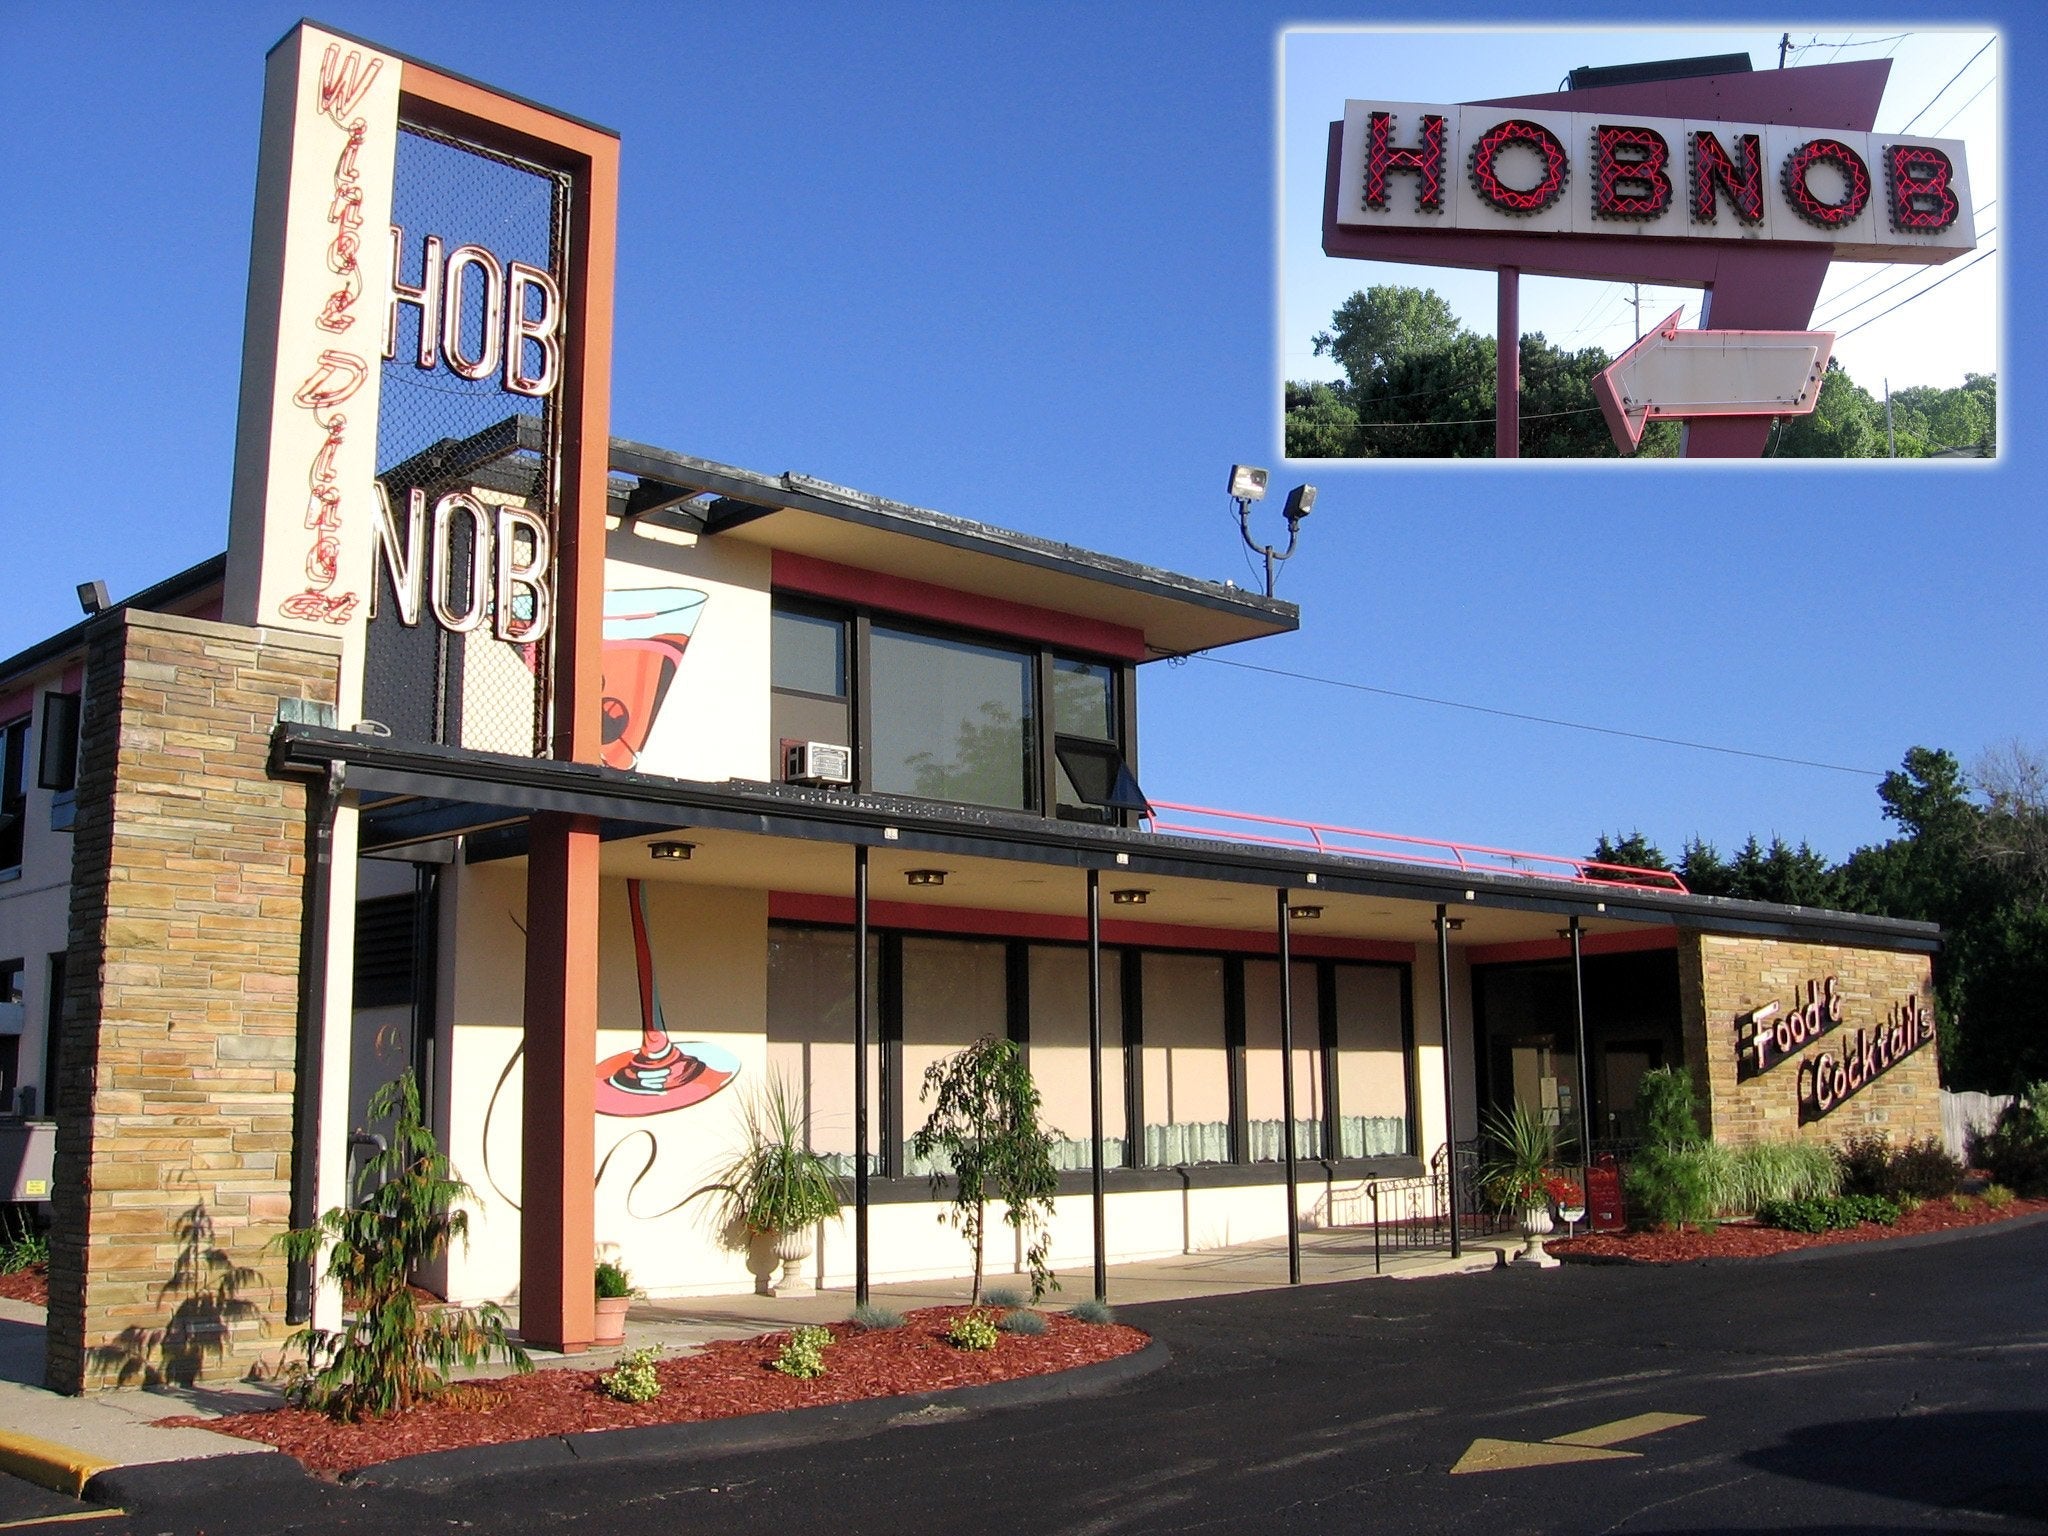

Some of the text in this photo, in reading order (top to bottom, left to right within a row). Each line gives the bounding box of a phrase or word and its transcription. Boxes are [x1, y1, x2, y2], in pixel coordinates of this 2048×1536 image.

[1361, 110, 1961, 234] HOBNOB
[378, 225, 561, 397] HOB
[367, 480, 551, 643] NOB
[1752, 979, 1822, 1069] Food
[1814, 994, 1934, 1110] Cocktails
